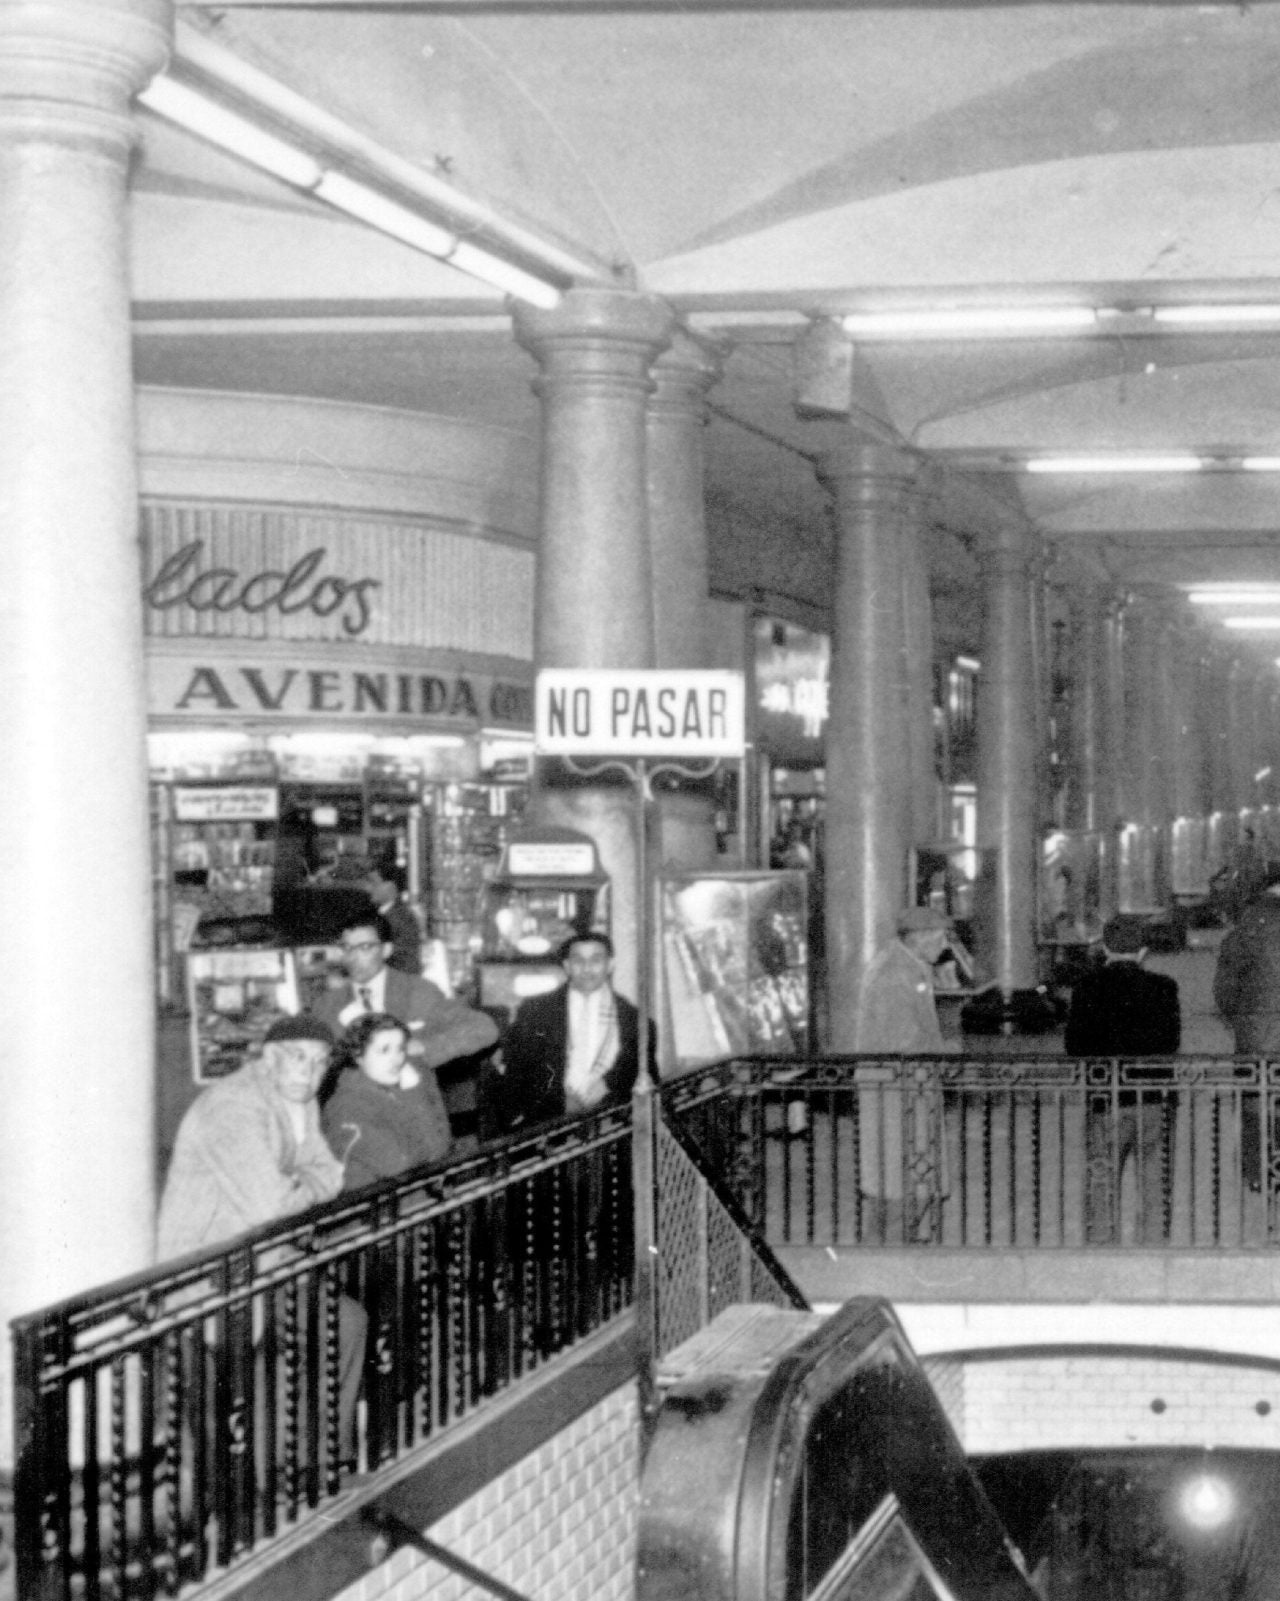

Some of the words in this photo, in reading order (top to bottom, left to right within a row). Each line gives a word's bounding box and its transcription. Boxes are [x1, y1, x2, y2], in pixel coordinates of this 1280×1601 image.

[174, 666, 479, 718] AVENIDA
[548, 687, 591, 738] NO
[611, 687, 727, 738] PASAR
